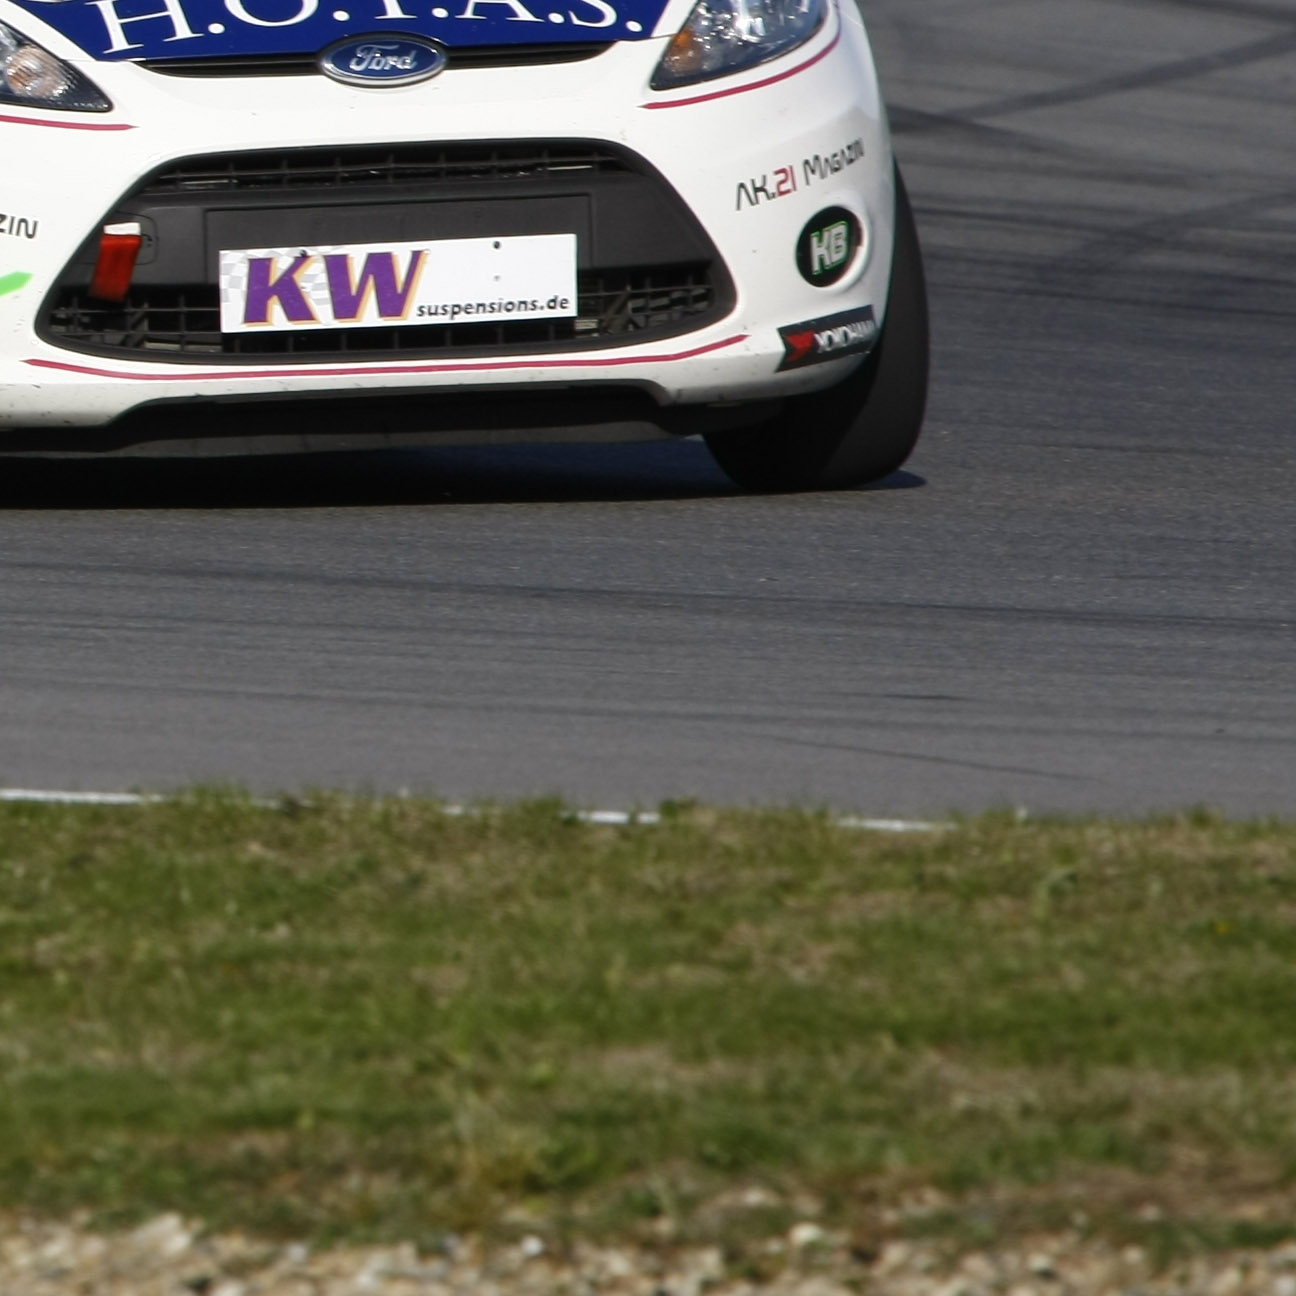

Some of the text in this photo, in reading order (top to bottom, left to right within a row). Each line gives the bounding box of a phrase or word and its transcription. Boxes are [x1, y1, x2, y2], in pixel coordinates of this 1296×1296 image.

[349, 43, 418, 72] Ford
[735, 164, 797, 211] AK.21
[810, 220, 849, 275] KB
[243, 250, 570, 326] KW suspensions.de
